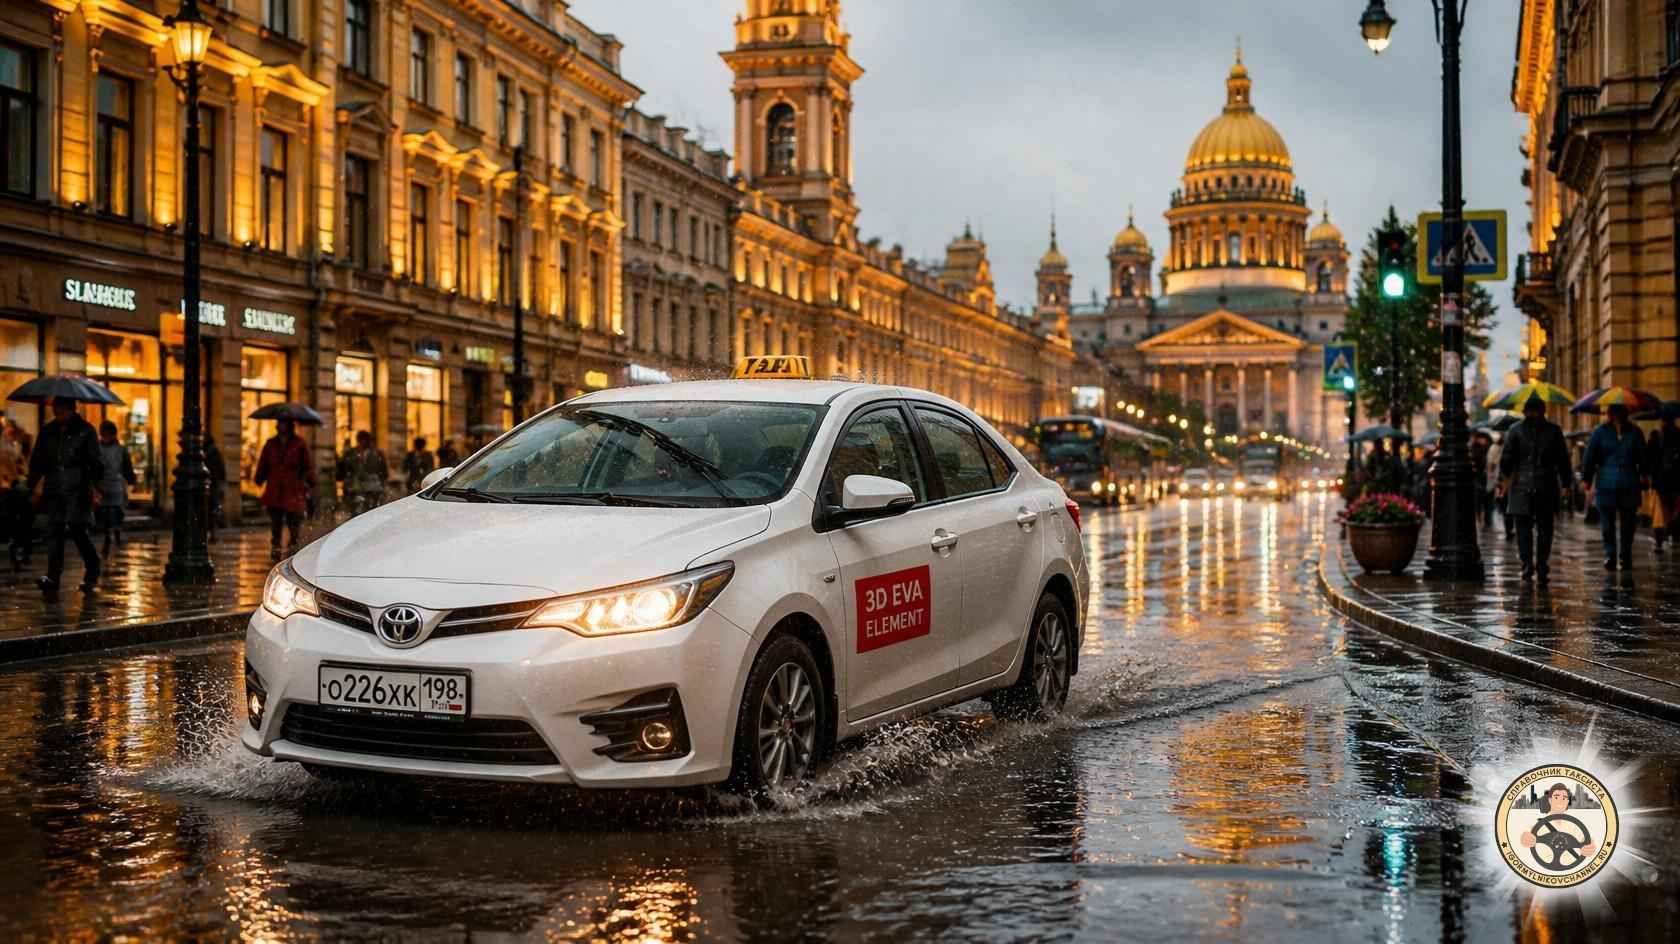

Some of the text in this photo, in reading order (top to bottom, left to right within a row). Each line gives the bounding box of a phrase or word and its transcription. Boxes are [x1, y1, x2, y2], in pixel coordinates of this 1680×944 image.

[865, 579, 924, 613] 3D EVA
[866, 608, 924, 638] ELEMENT
[422, 677, 458, 700] 198
